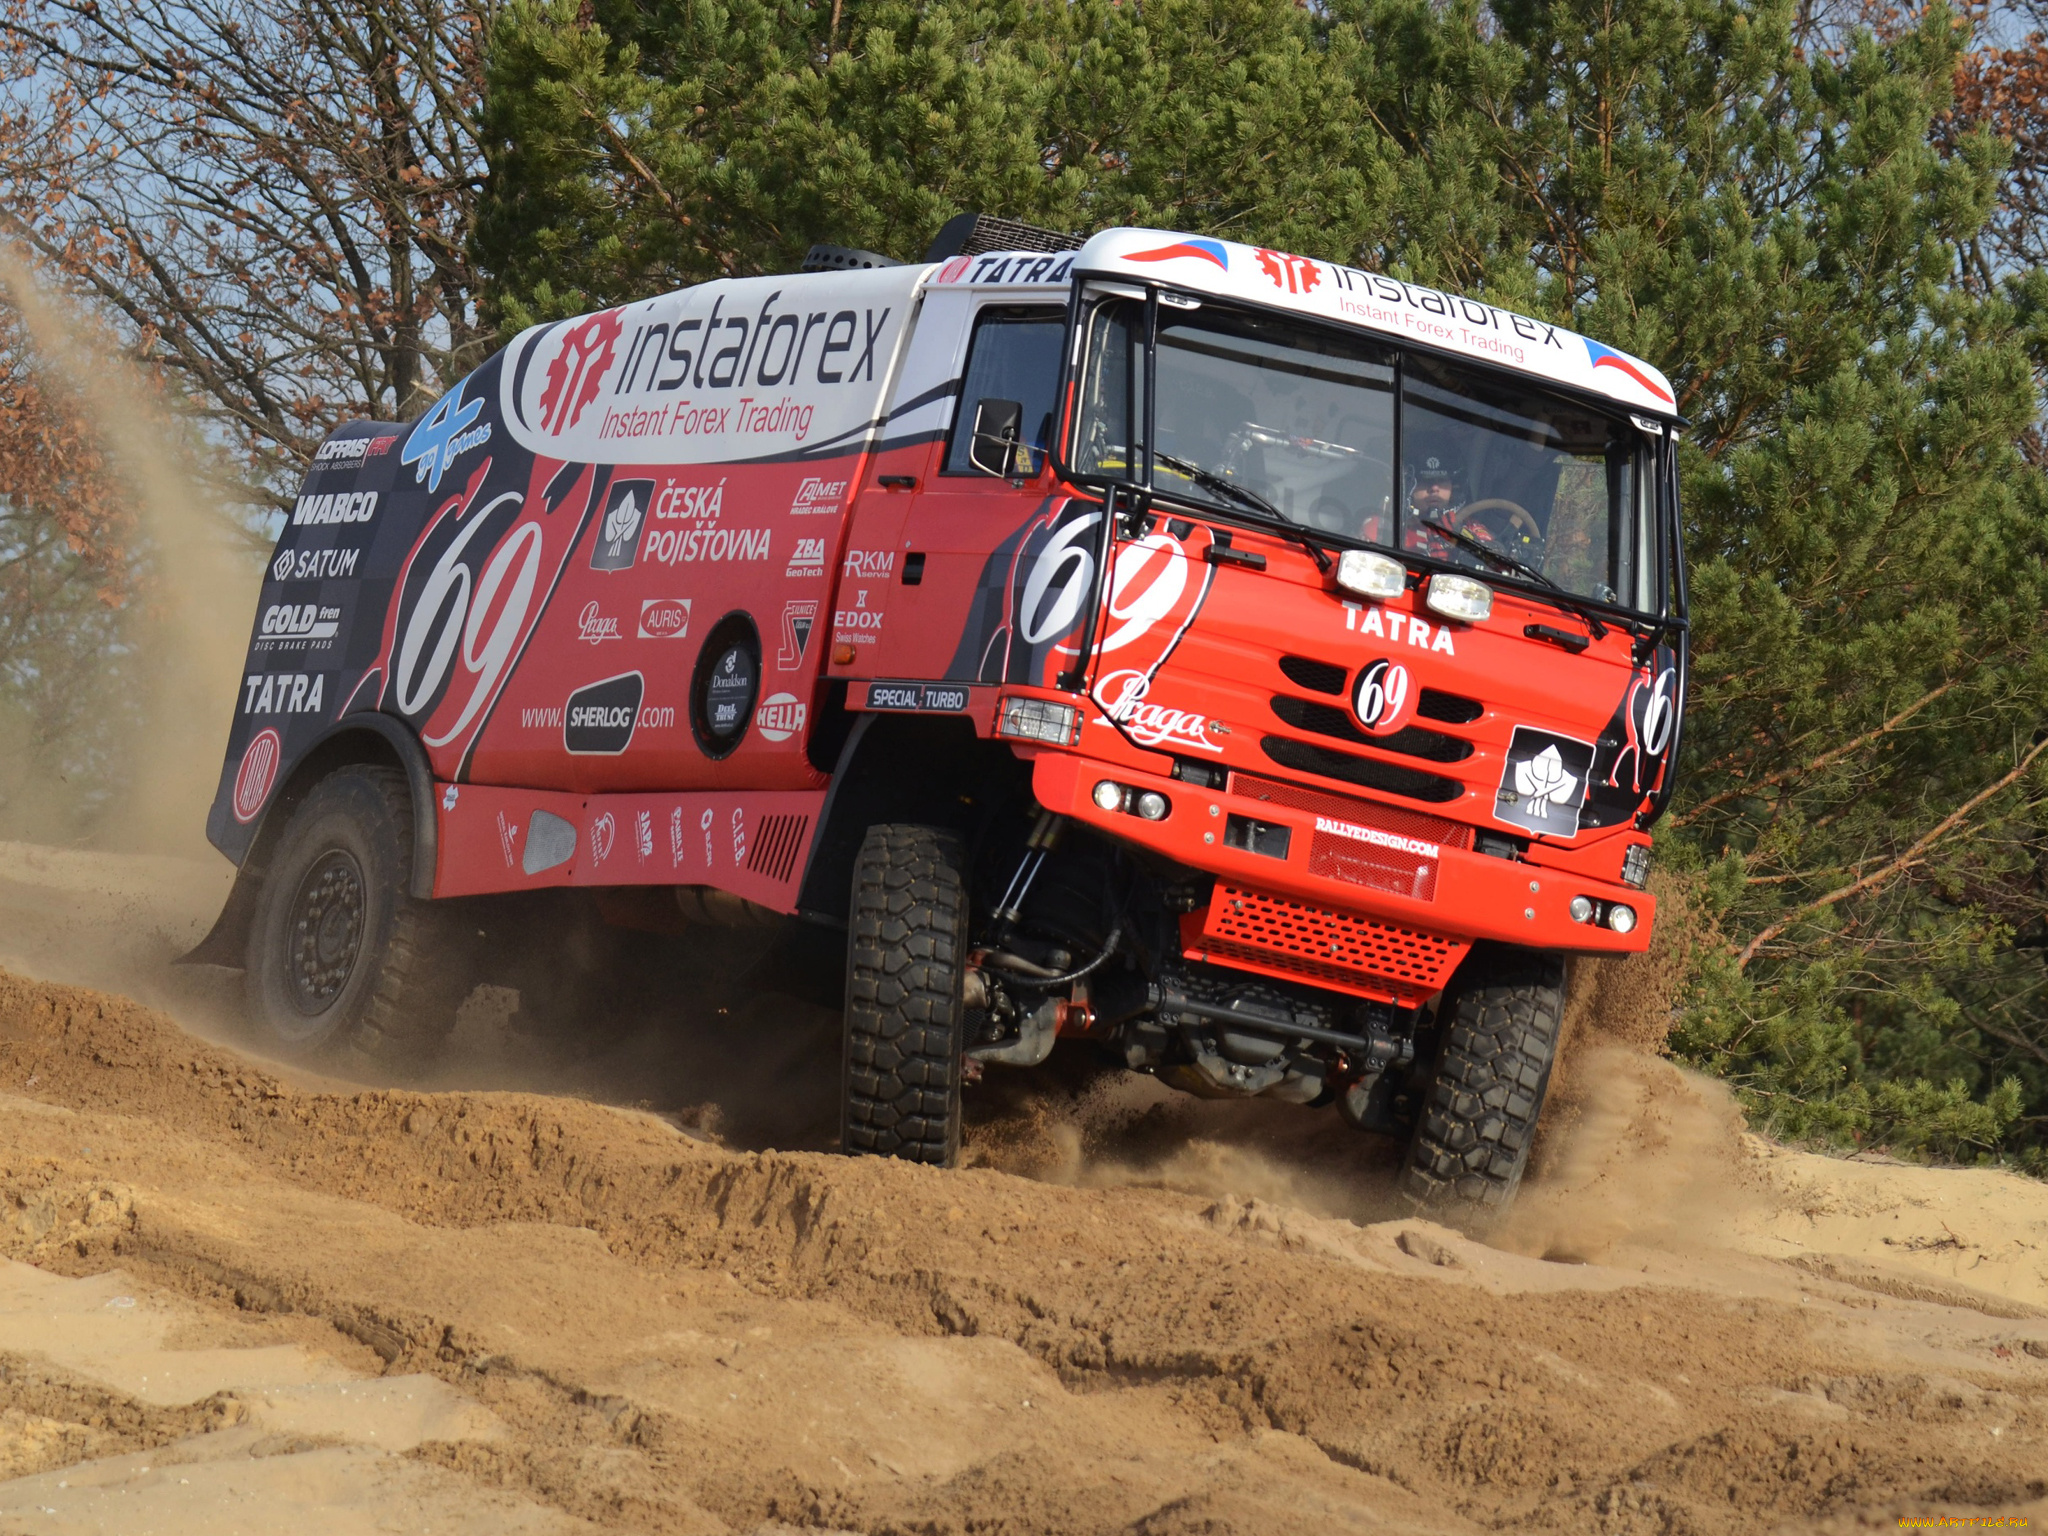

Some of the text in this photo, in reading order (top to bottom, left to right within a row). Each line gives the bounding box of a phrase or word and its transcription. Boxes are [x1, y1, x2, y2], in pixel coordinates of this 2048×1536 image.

[970, 257, 1075, 283] TATRA
[1331, 264, 1564, 350] instaforex
[614, 289, 891, 395] instaforex
[1338, 296, 1524, 363] Instant Forex Trading
[599, 397, 814, 441] Instant Forex Trading
[443, 422, 492, 471] games
[292, 491, 378, 525] WABCO
[655, 477, 728, 519] ČESKÁ
[642, 520, 772, 567] POJIŠŤOVNA
[792, 538, 825, 559] ZBA
[294, 549, 360, 578] SATUM
[785, 567, 824, 577] GeoTech
[844, 550, 895, 578] RKM
[861, 571, 890, 579] servis
[1019, 511, 1188, 656] 69
[262, 604, 341, 634] GOLD fren
[396, 491, 543, 748] 69
[578, 601, 623, 645] Praga
[646, 609, 683, 628] AURIS
[833, 611, 884, 629] EDOX
[1341, 600, 1455, 656] TATRA
[255, 640, 333, 651] DISC BRAKE PADS
[836, 632, 876, 645] Swiss Watches
[244, 674, 325, 714] TATRA
[712, 673, 748, 688] Donaldson
[873, 688, 964, 708] SPECIAL TURBO
[1357, 662, 1408, 726] 69
[521, 706, 675, 728] www. SHERLOG .com
[757, 703, 806, 732] HELLA
[1092, 669, 1224, 754] Praga
[731, 807, 746, 867] C.I.E.B.
[1316, 817, 1439, 859] RALLYEDESIGN.COM
